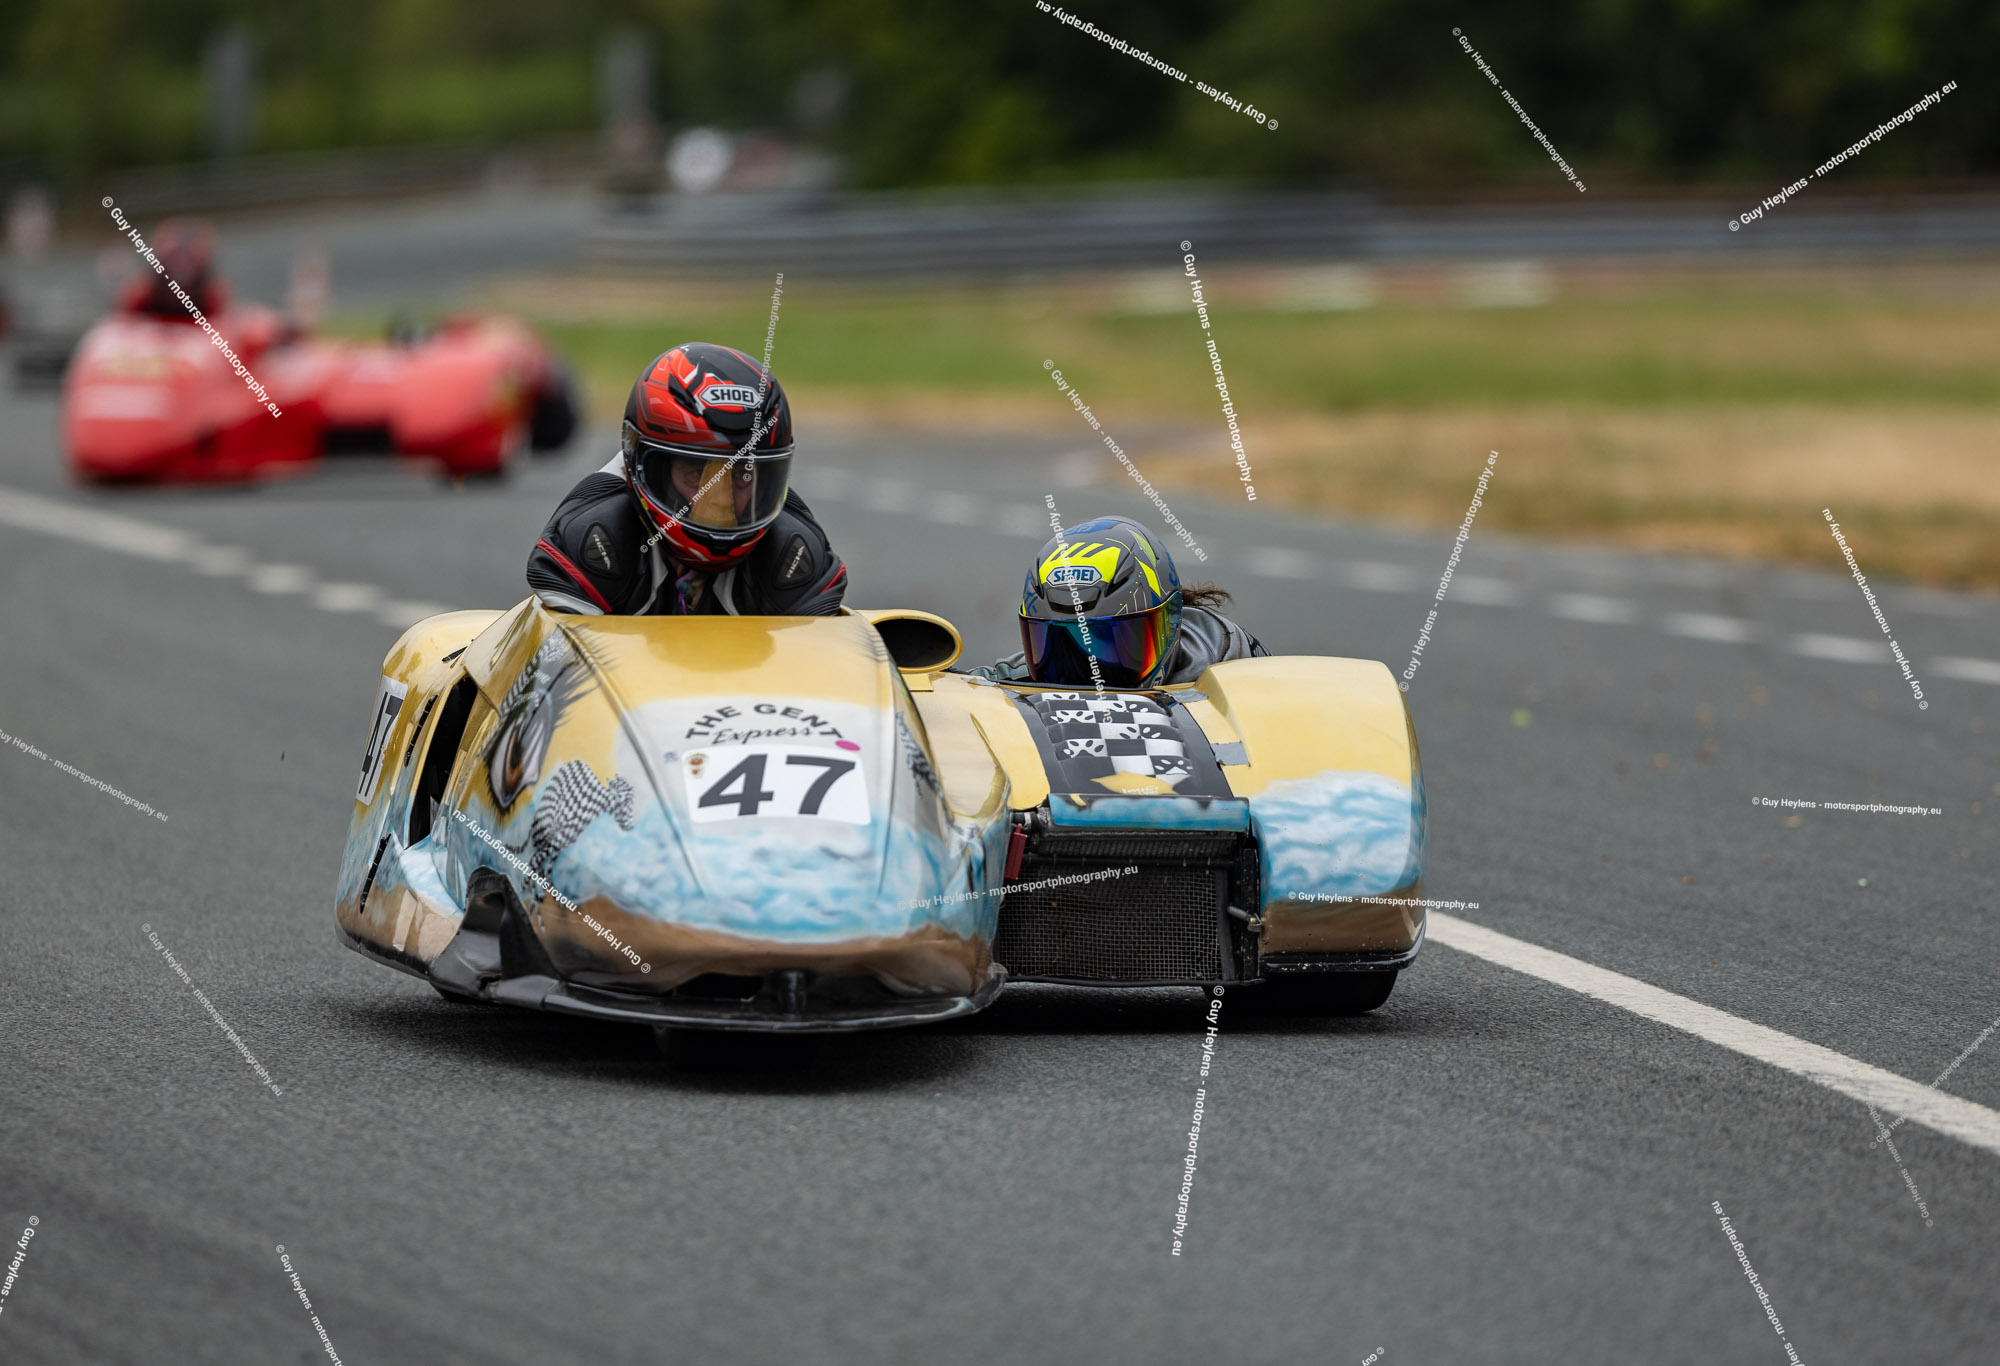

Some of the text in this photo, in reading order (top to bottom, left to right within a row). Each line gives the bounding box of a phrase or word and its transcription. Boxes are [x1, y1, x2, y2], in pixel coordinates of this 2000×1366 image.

[710, 388, 755, 404] SHOEI
[685, 703, 843, 739] THE GENT
[712, 726, 815, 745] Express
[358, 691, 404, 797] 47
[697, 753, 856, 816] 47
